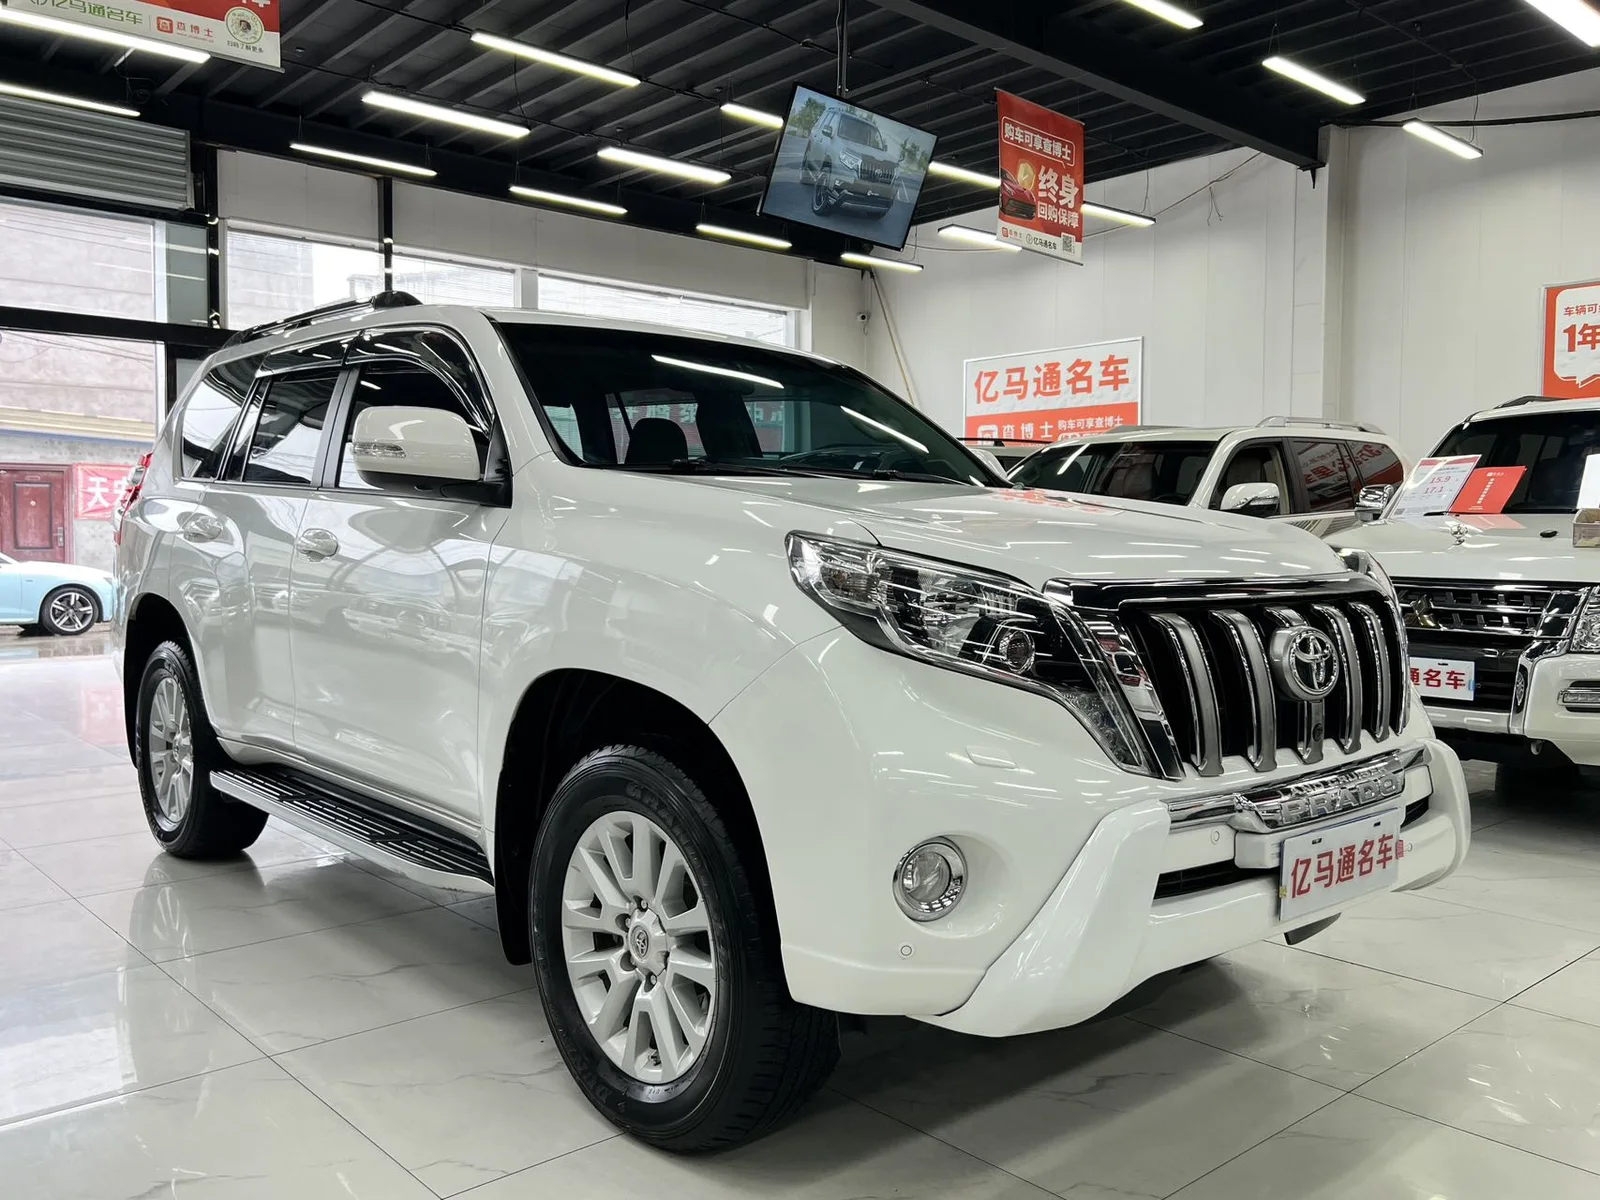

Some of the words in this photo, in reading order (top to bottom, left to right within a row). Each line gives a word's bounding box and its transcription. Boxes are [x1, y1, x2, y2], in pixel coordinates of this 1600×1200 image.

[1004, 122, 1072, 162] 购车可享查博士
[1037, 165, 1079, 209] 终身
[1037, 202, 1079, 229] 回购保障
[1563, 303, 1600, 316] 车辆可
[974, 354, 1129, 404] 亿马通名车
[1057, 415, 1123, 431] 购车可享查博士
[1280, 773, 1400, 824] PRADO
[1291, 833, 1394, 899] 亿马通名车
